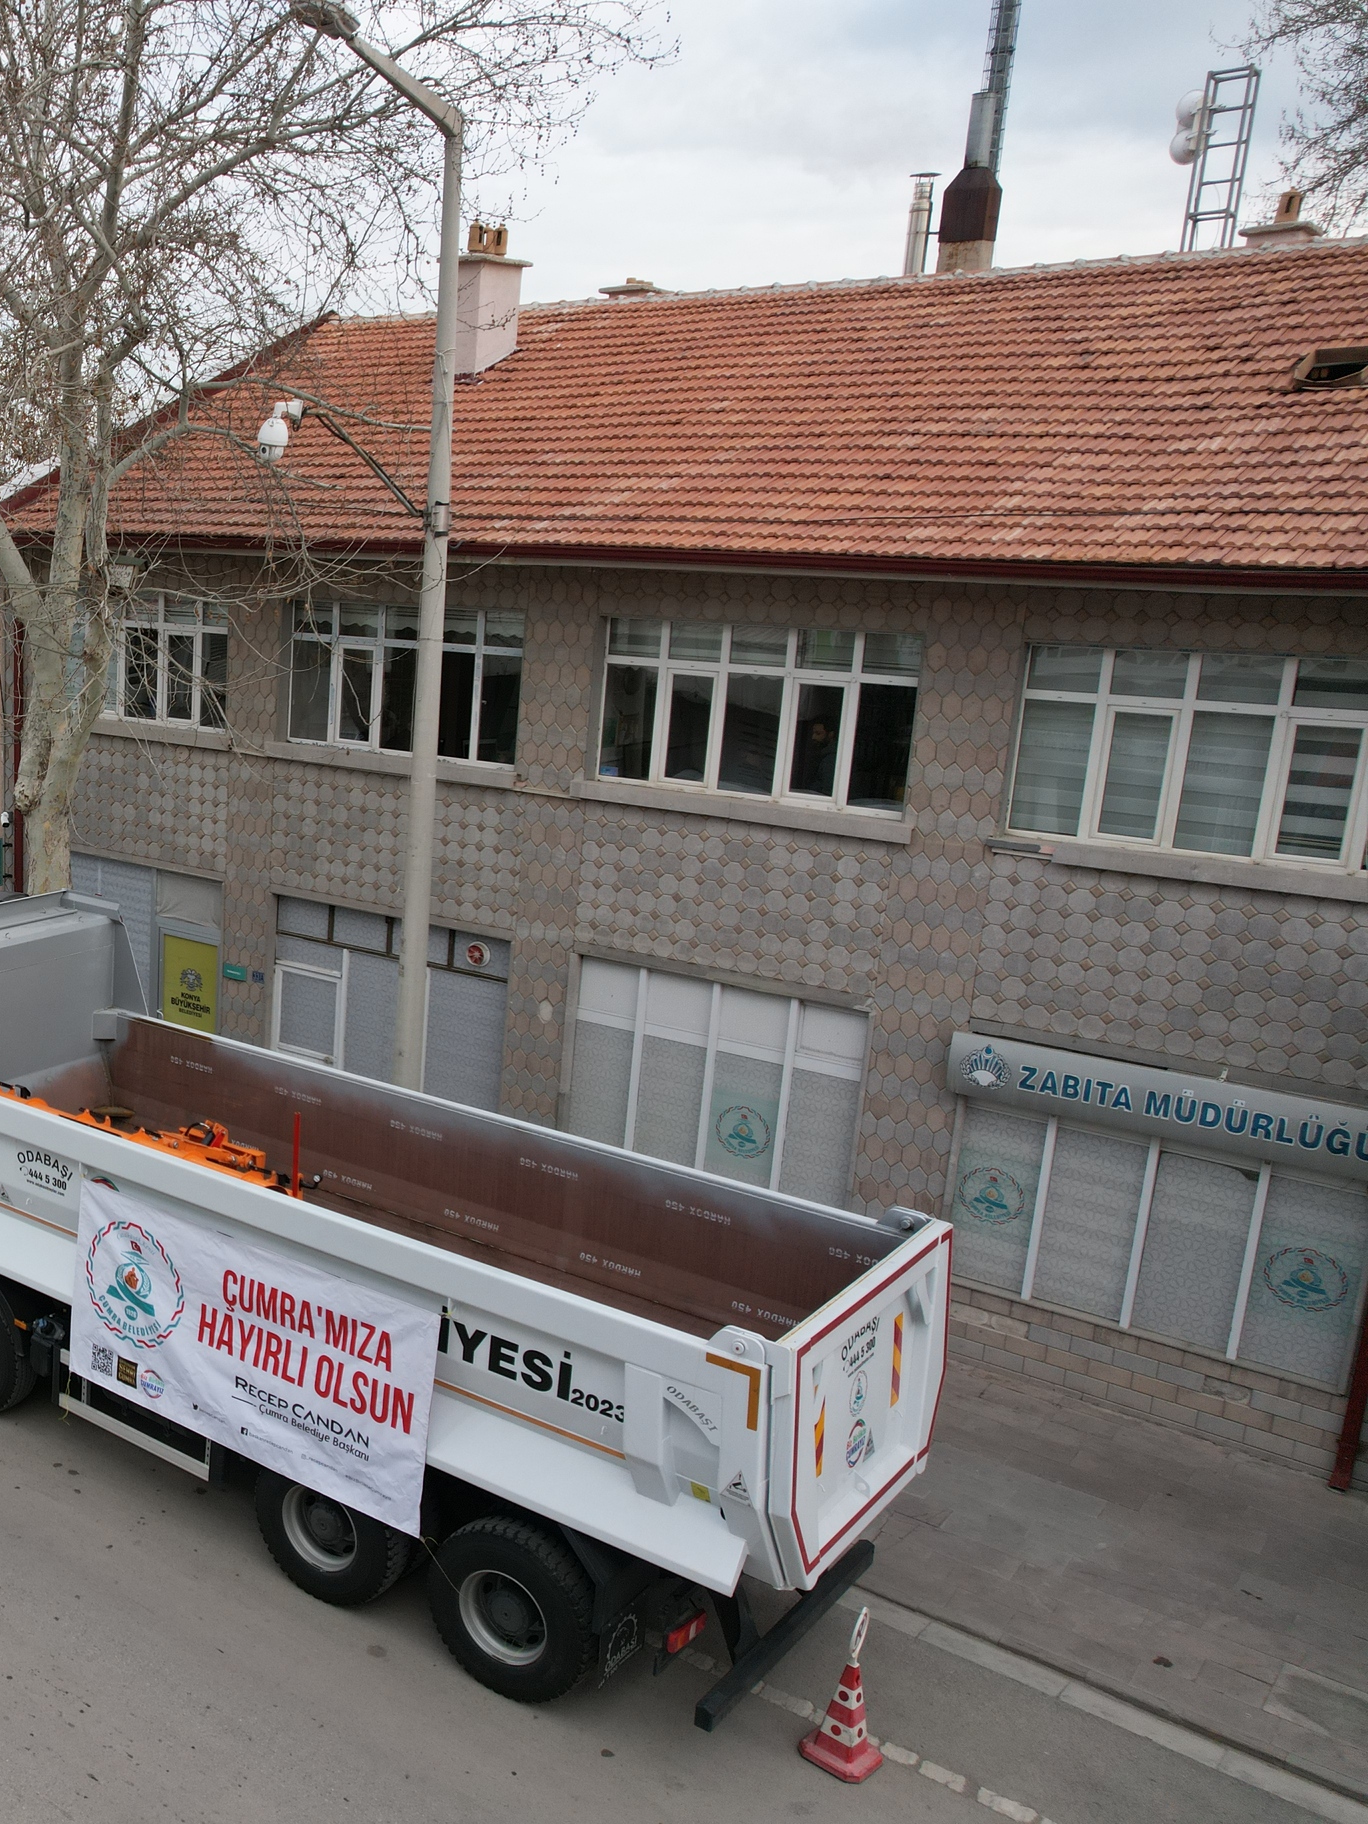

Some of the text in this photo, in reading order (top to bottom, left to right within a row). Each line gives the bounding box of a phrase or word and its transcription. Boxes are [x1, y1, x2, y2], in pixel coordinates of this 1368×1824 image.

[181, 992, 201, 1002] KONYA
[1017, 1065, 1133, 1112] ZABITA
[390, 1119, 443, 1142] HARDOX 450
[17, 1150, 73, 1181] ODABAŞI
[520, 1157, 579, 1181] HARDOX 450
[28, 1168, 67, 1190] 444 5 300
[323, 1169, 373, 1191] HARDOX 450
[444, 1208, 500, 1232] HARDOX 450
[665, 1199, 731, 1225] HARDOX 450
[579, 1252, 641, 1277] HARDOX 450
[829, 1247, 850, 1259] 450
[99, 1295, 162, 1337] ÇUMRA BELEDİYESİ
[732, 1301, 752, 1313] 450
[223, 1270, 392, 1373] ÇUMRA'MIZA
[198, 1303, 414, 1435] HAYIRLI OLSUN
[235, 1375, 369, 1449] RECEP CANDAN
[570, 1389, 624, 1423] 2023
[667, 1385, 718, 1432] ODABAŞI
[259, 1404, 369, 1462] Çumra Belediye Başkanı
